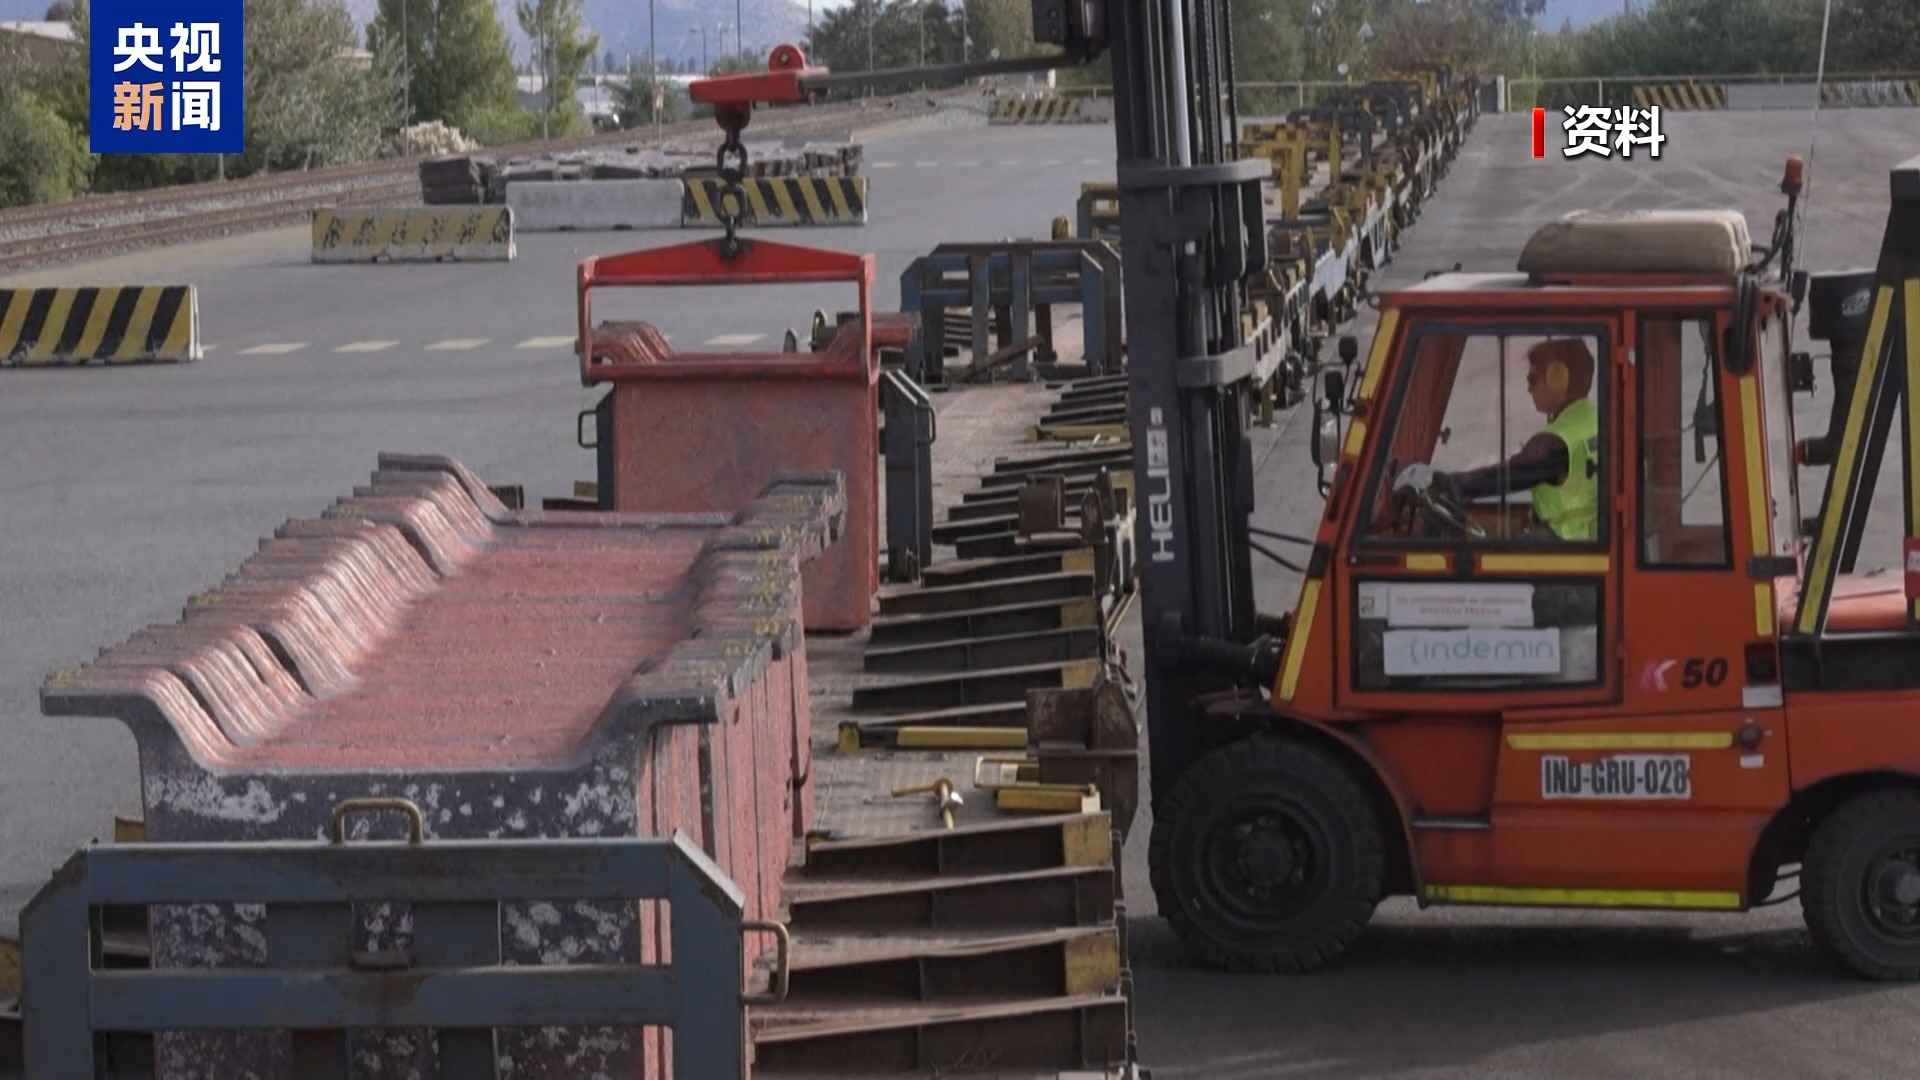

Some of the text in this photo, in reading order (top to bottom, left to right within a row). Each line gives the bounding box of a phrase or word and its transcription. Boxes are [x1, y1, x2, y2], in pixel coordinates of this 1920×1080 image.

[1147, 467, 1175, 563] HELI
[1681, 657, 1729, 689] 50
[1544, 759, 1688, 795] IND-GRU-028
